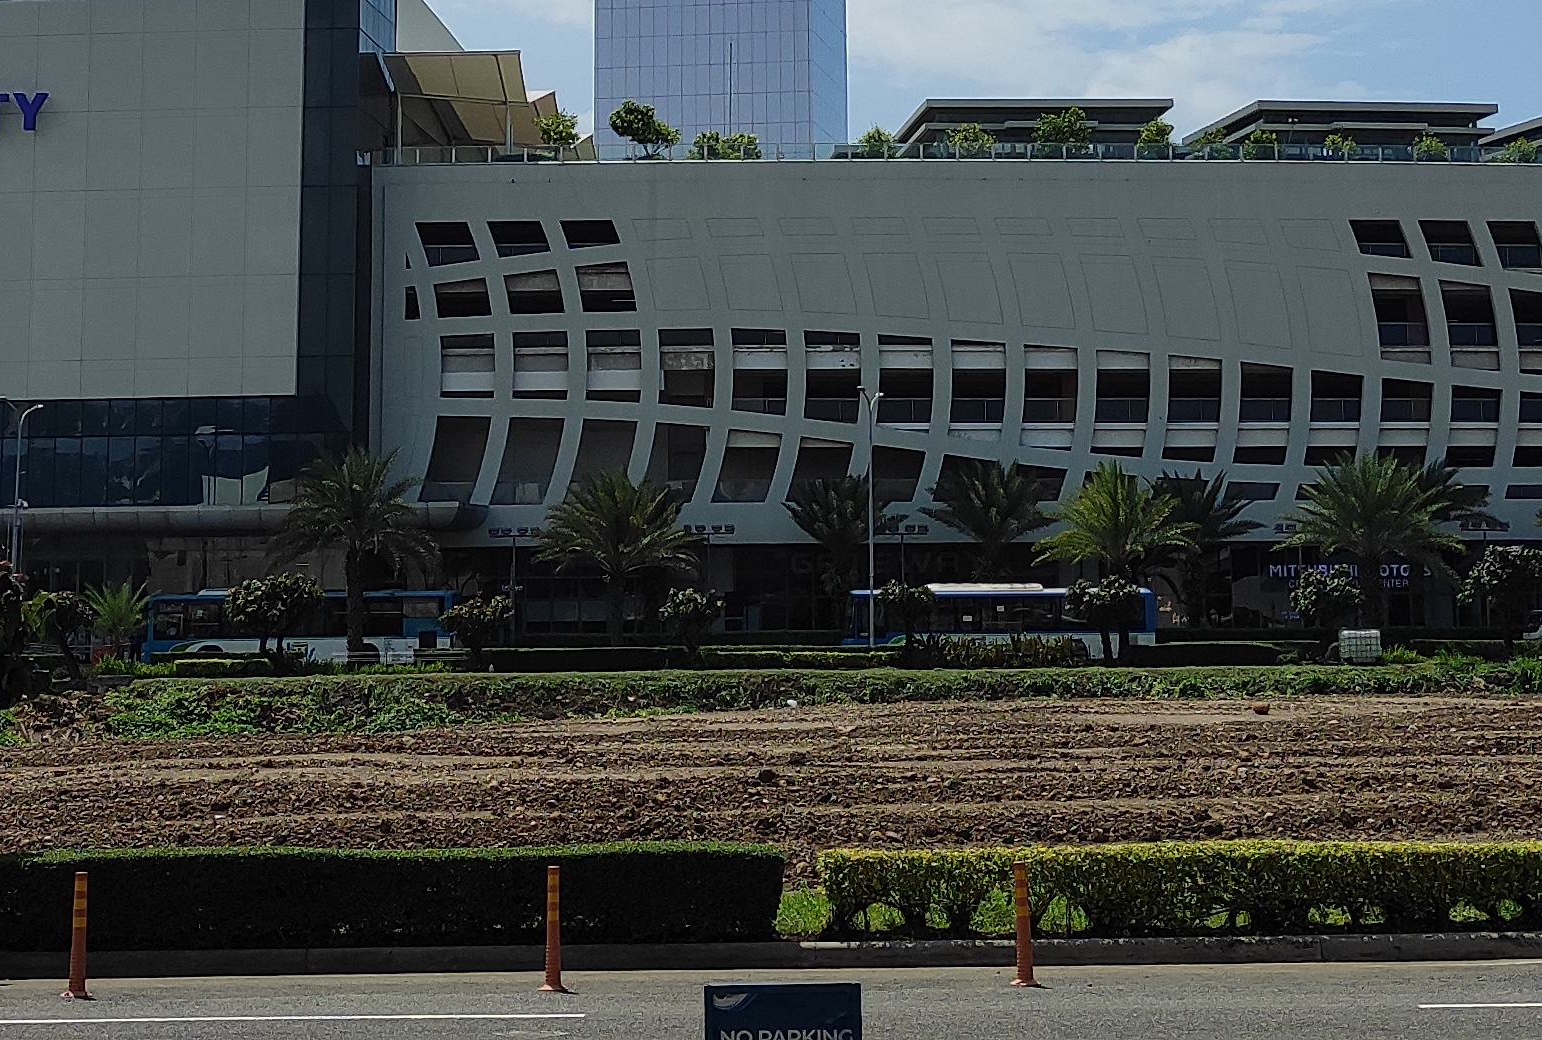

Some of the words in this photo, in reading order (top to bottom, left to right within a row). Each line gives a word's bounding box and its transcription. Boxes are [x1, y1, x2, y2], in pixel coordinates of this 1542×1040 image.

[1367, 564, 1433, 577] OTOS
[720, 1029, 754, 1040] NO
[758, 1028, 854, 1040] PARKING
